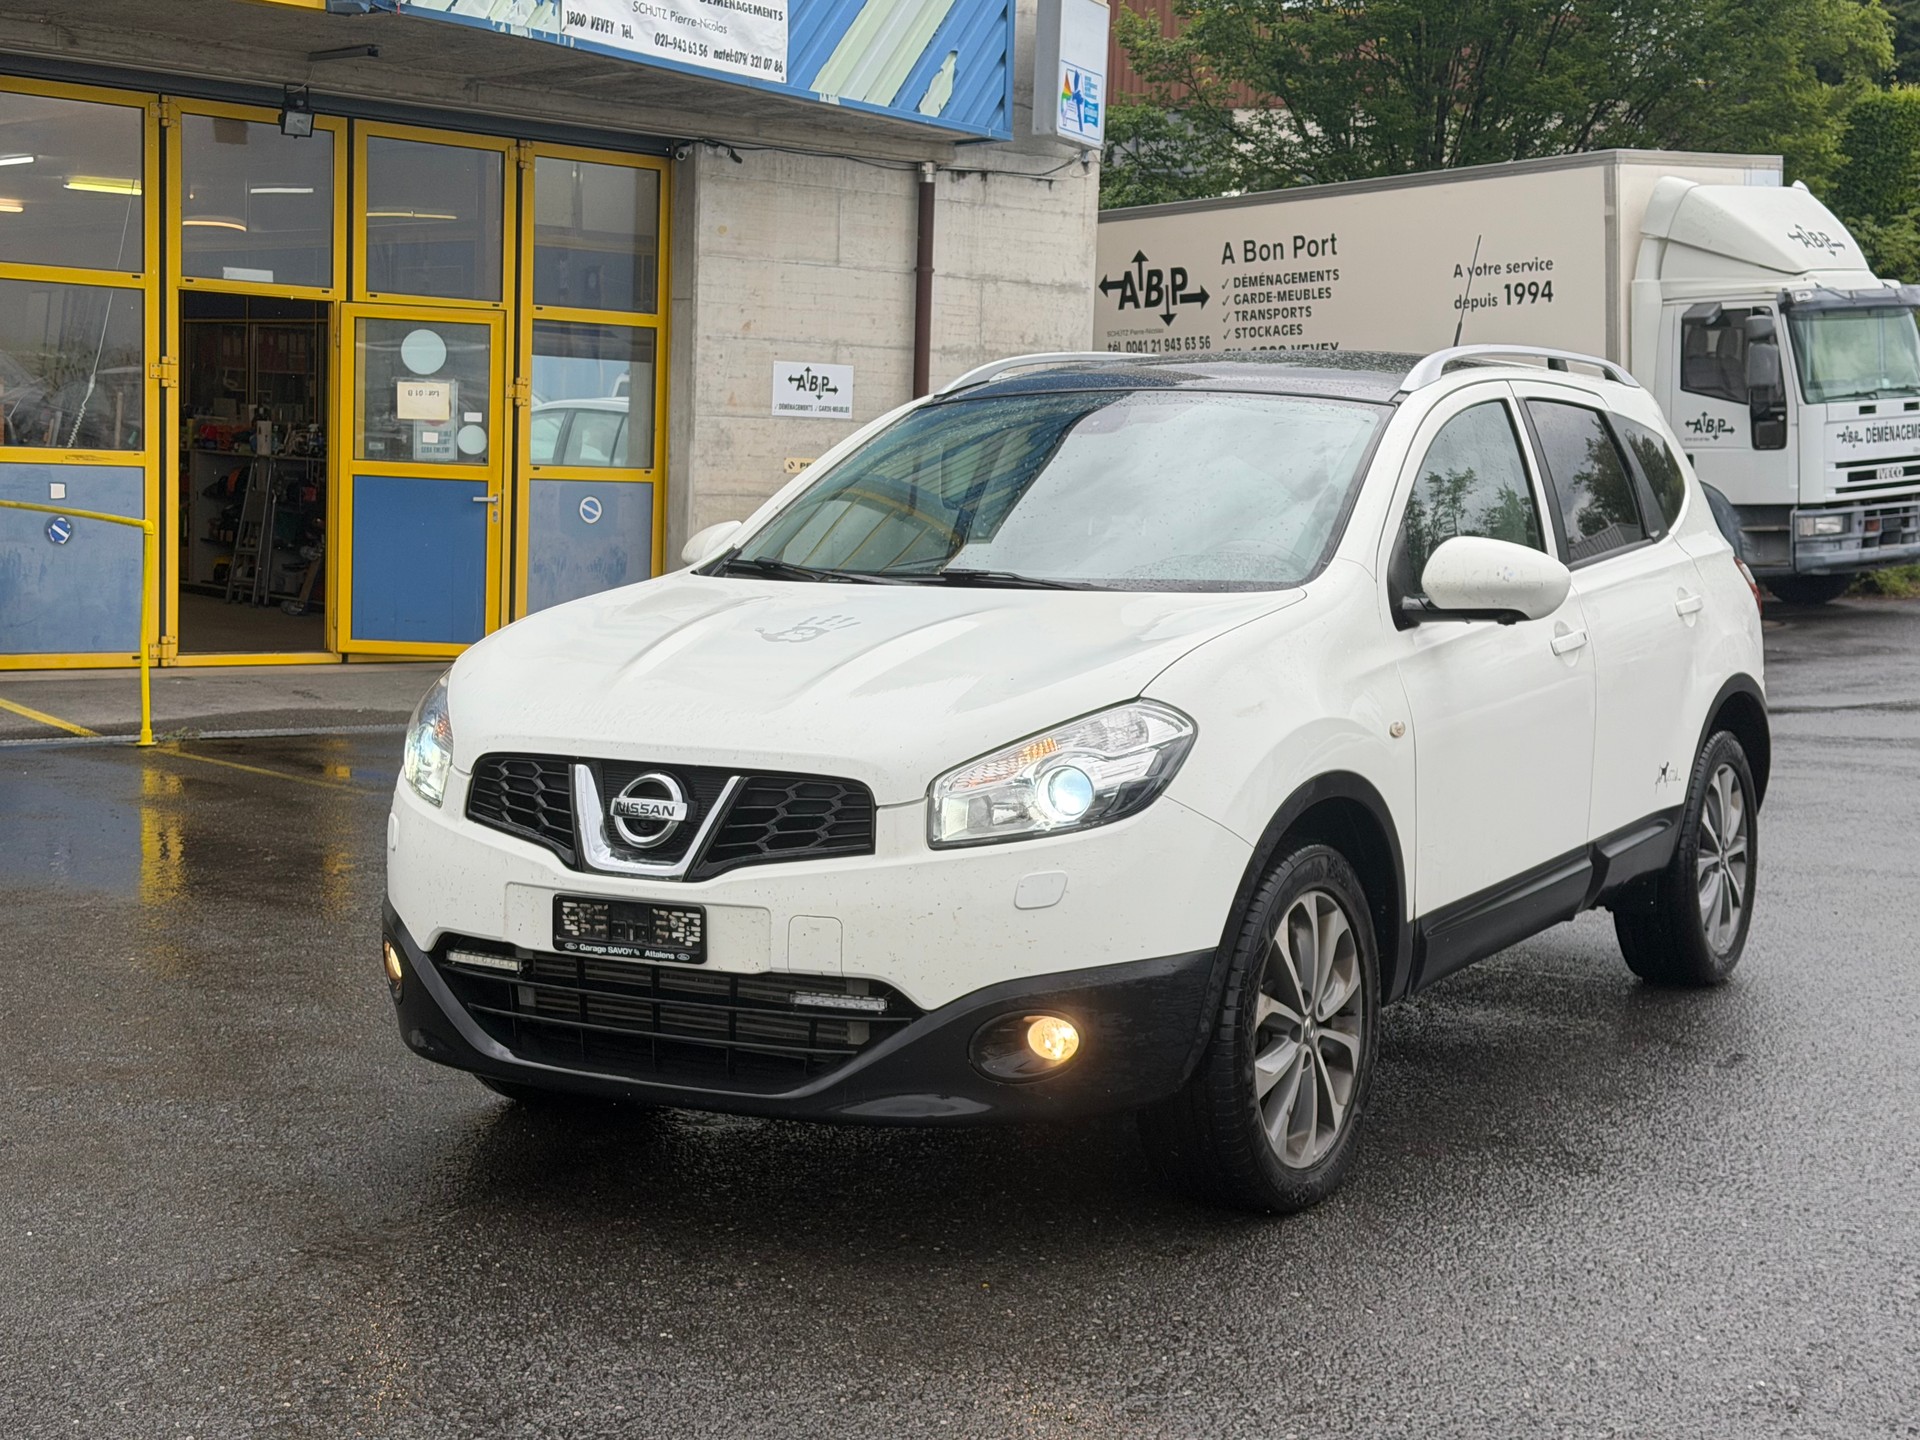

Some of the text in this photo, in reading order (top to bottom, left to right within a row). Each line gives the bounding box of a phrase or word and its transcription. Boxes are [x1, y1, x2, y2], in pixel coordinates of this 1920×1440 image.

[670, 11, 728, 34] Pierre-Nicolas
[566, 10, 586, 27] 1800
[590, 15, 615, 34] VEVEY
[621, 23, 634, 40] Tél.
[688, 41, 698, 55] 63
[698, 43, 708, 58] 56
[750, 54, 762, 68] 321
[763, 57, 772, 71] 07
[774, 60, 783, 73] 86
[1221, 233, 1338, 265] A Bon Port
[1453, 256, 1554, 278] A votre service
[1118, 266, 1188, 310] ABP
[1233, 268, 1340, 289] DÉMÉNAGEMENTS
[1233, 286, 1332, 305] GARDE-MEUBLES
[1454, 280, 1554, 312] depuis 1994
[1234, 305, 1312, 322] TRANSPORTS
[1234, 323, 1303, 339] STOCKAGES
[1126, 339, 1148, 353] 0041
[1151, 338, 1161, 352] 21
[1164, 337, 1181, 352] 943
[1184, 336, 1197, 351] 63
[1199, 335, 1211, 350] 56
[1693, 418, 1726, 434] ABP
[616, 801, 676, 817] NISSAN
[580, 943, 606, 953] Garage
[608, 946, 633, 955] SAVOY
